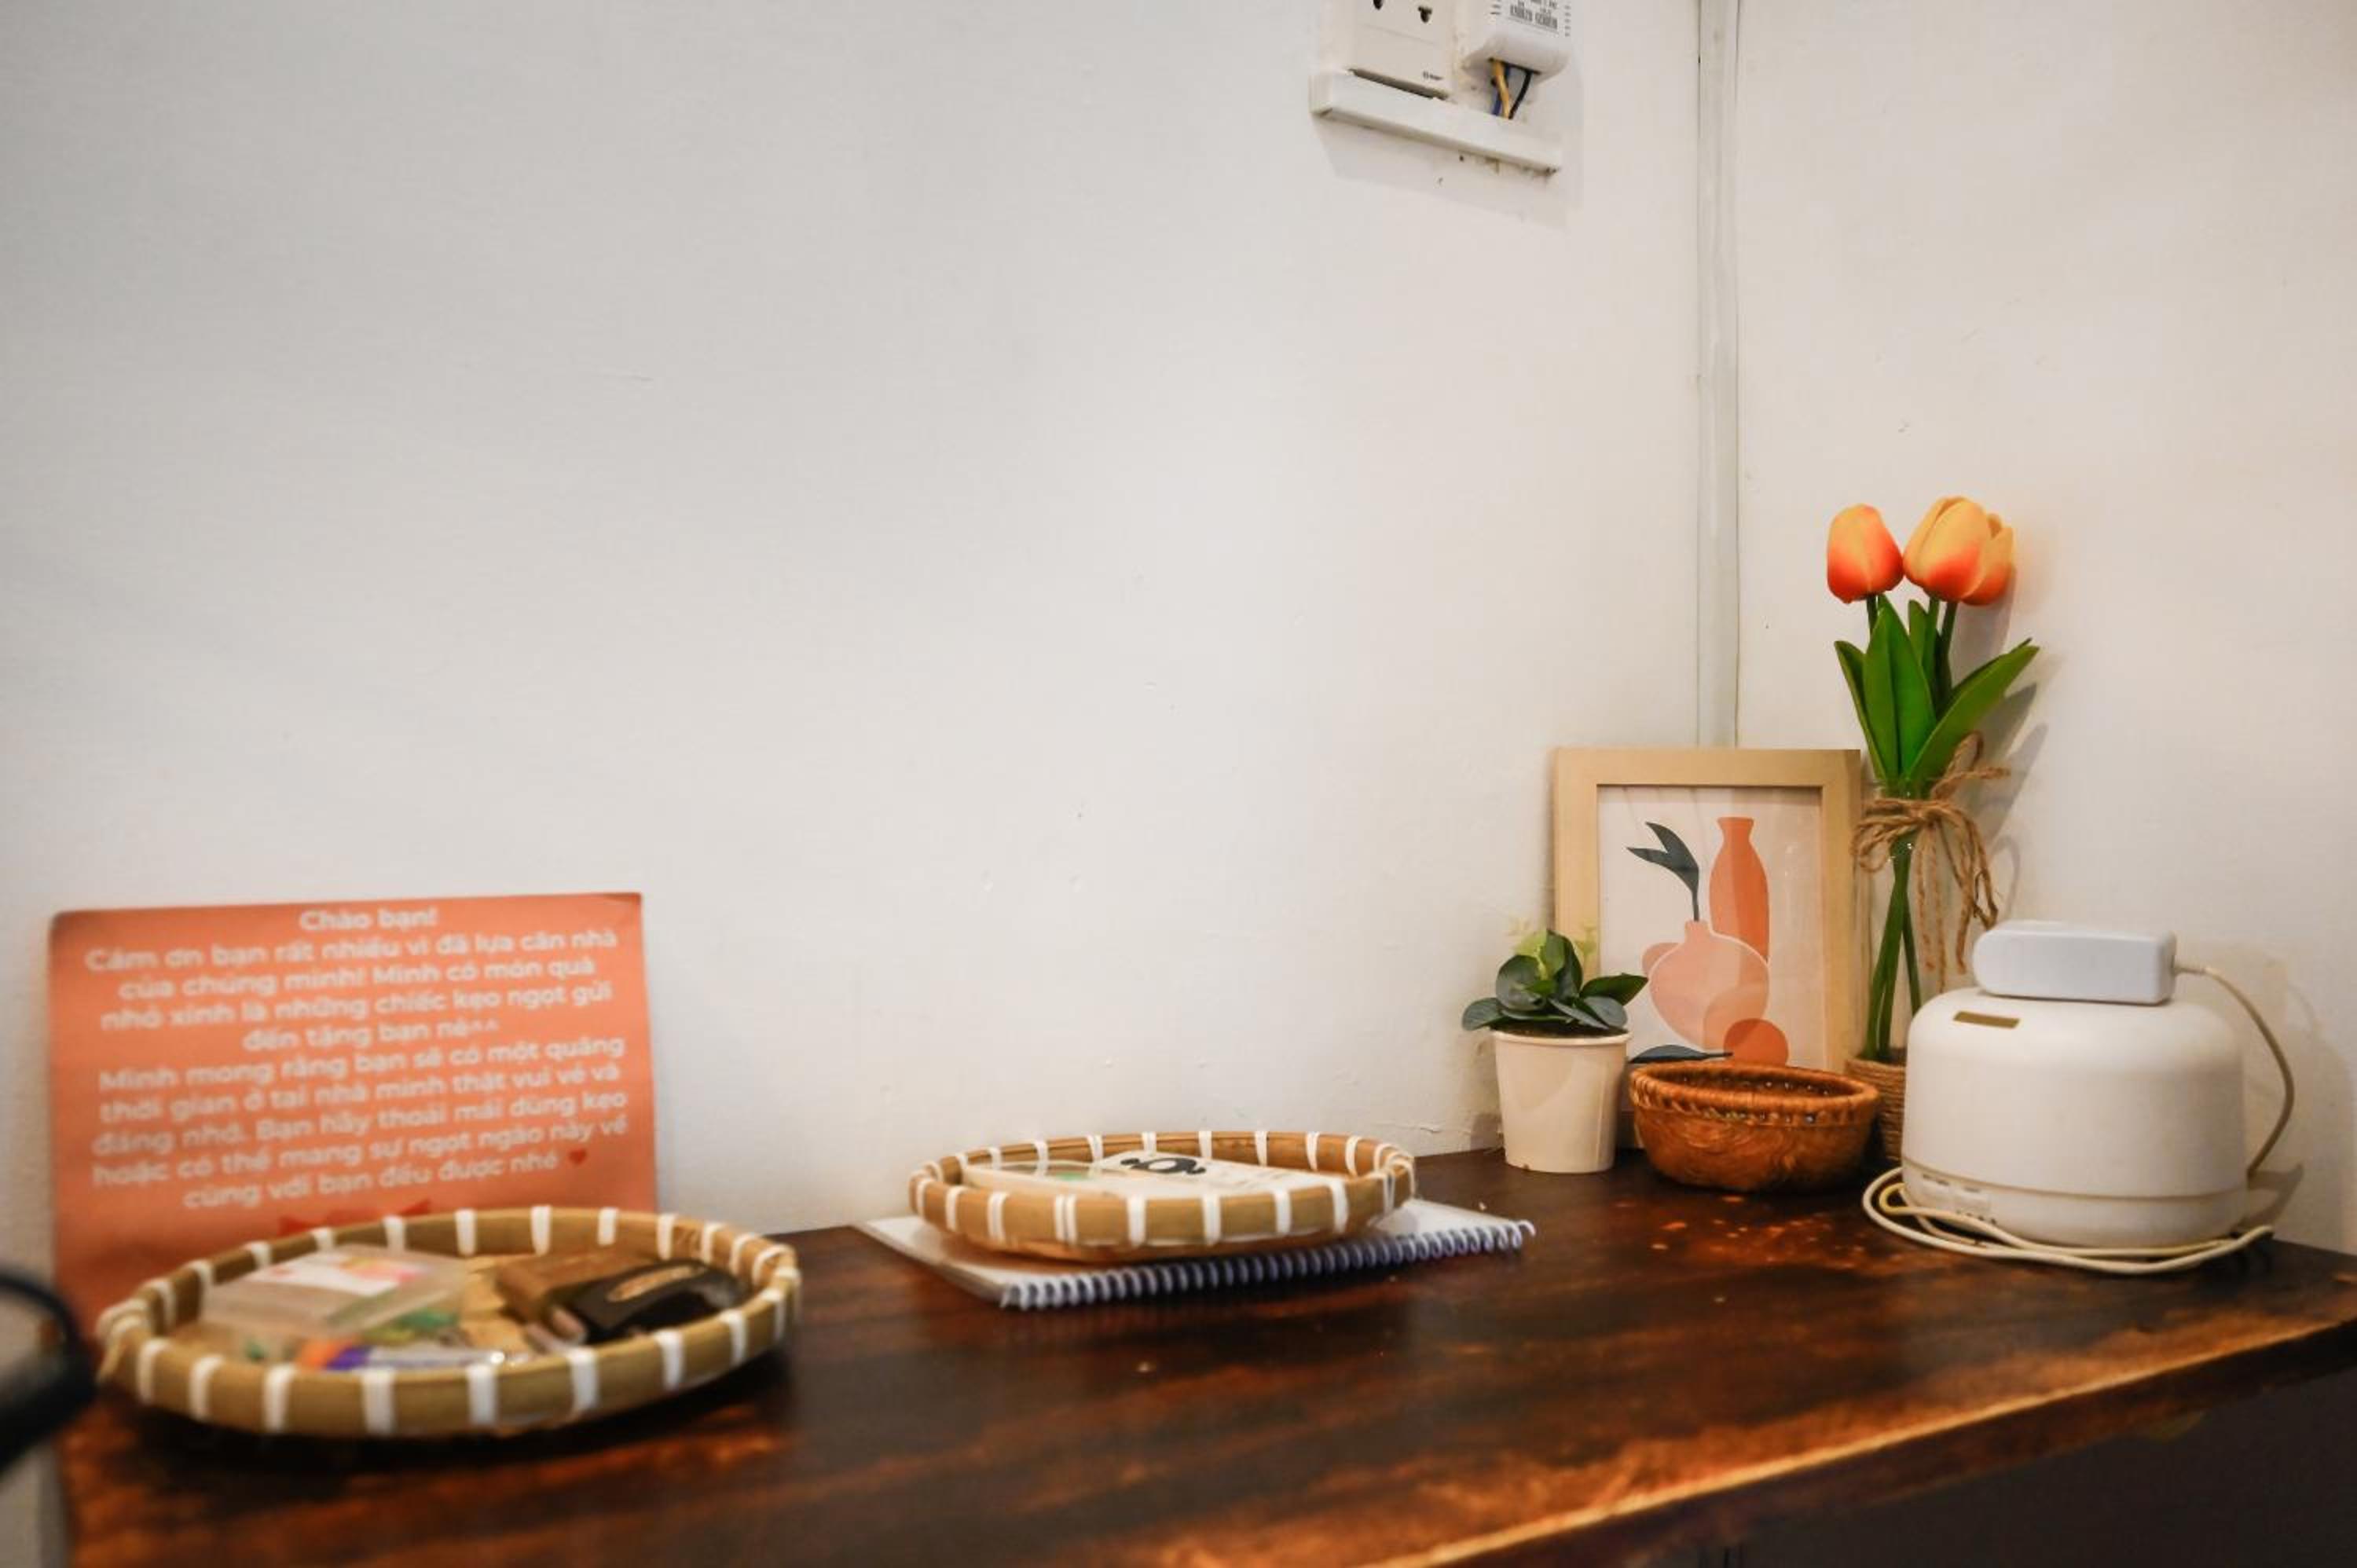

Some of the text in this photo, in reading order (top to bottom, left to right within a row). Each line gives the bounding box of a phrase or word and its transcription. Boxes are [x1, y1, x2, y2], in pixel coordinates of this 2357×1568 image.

[170, 1007, 233, 1025] xinh
[186, 1066, 272, 1085] mong
[170, 1096, 236, 1123] gian
[513, 1067, 550, 1087] vui
[280, 1145, 361, 1167] mang
